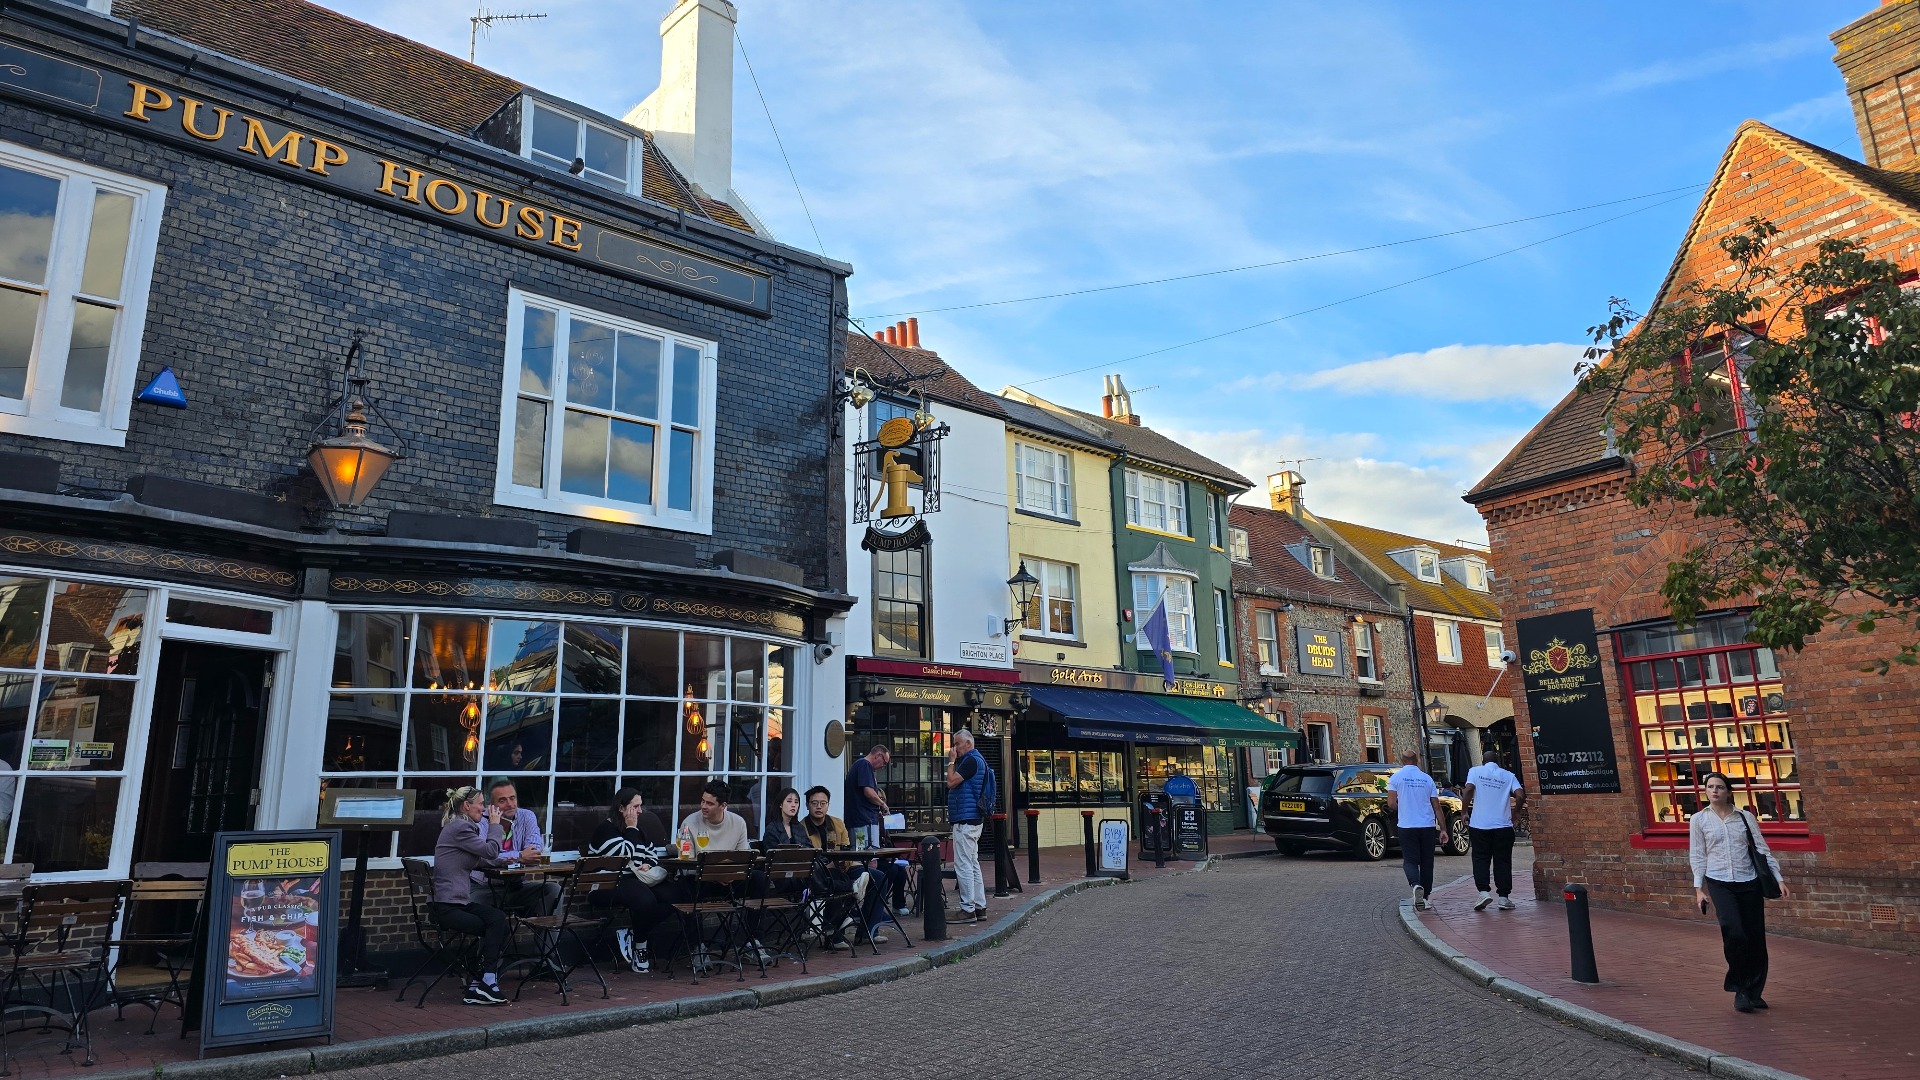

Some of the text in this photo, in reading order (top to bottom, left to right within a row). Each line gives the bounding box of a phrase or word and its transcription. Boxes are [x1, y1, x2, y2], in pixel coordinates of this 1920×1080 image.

[124, 80, 584, 253] PUMP HOUSE
[153, 387, 179, 397] Chubb
[869, 527, 921, 548] PUMP HOUSE
[1313, 634, 1328, 644] THE
[962, 649, 1004, 660] BRIGHTON PLACE
[1306, 644, 1336, 657] DRUIDS
[1311, 656, 1334, 668] HEAD
[922, 666, 962, 678] Classic Jewellery
[1051, 668, 1103, 684] Gold Arts
[1539, 675, 1585, 686] BELLA WATCH
[1547, 681, 1580, 690] BOUTIQUE
[895, 686, 951, 704] Classic Jewellery
[1537, 751, 1604, 764] 07362 732112
[269, 847, 290, 856] THE
[233, 856, 324, 871] PUMP HOUSE
[241, 914, 264, 923] FISH
[280, 912, 309, 920] CHIPS
